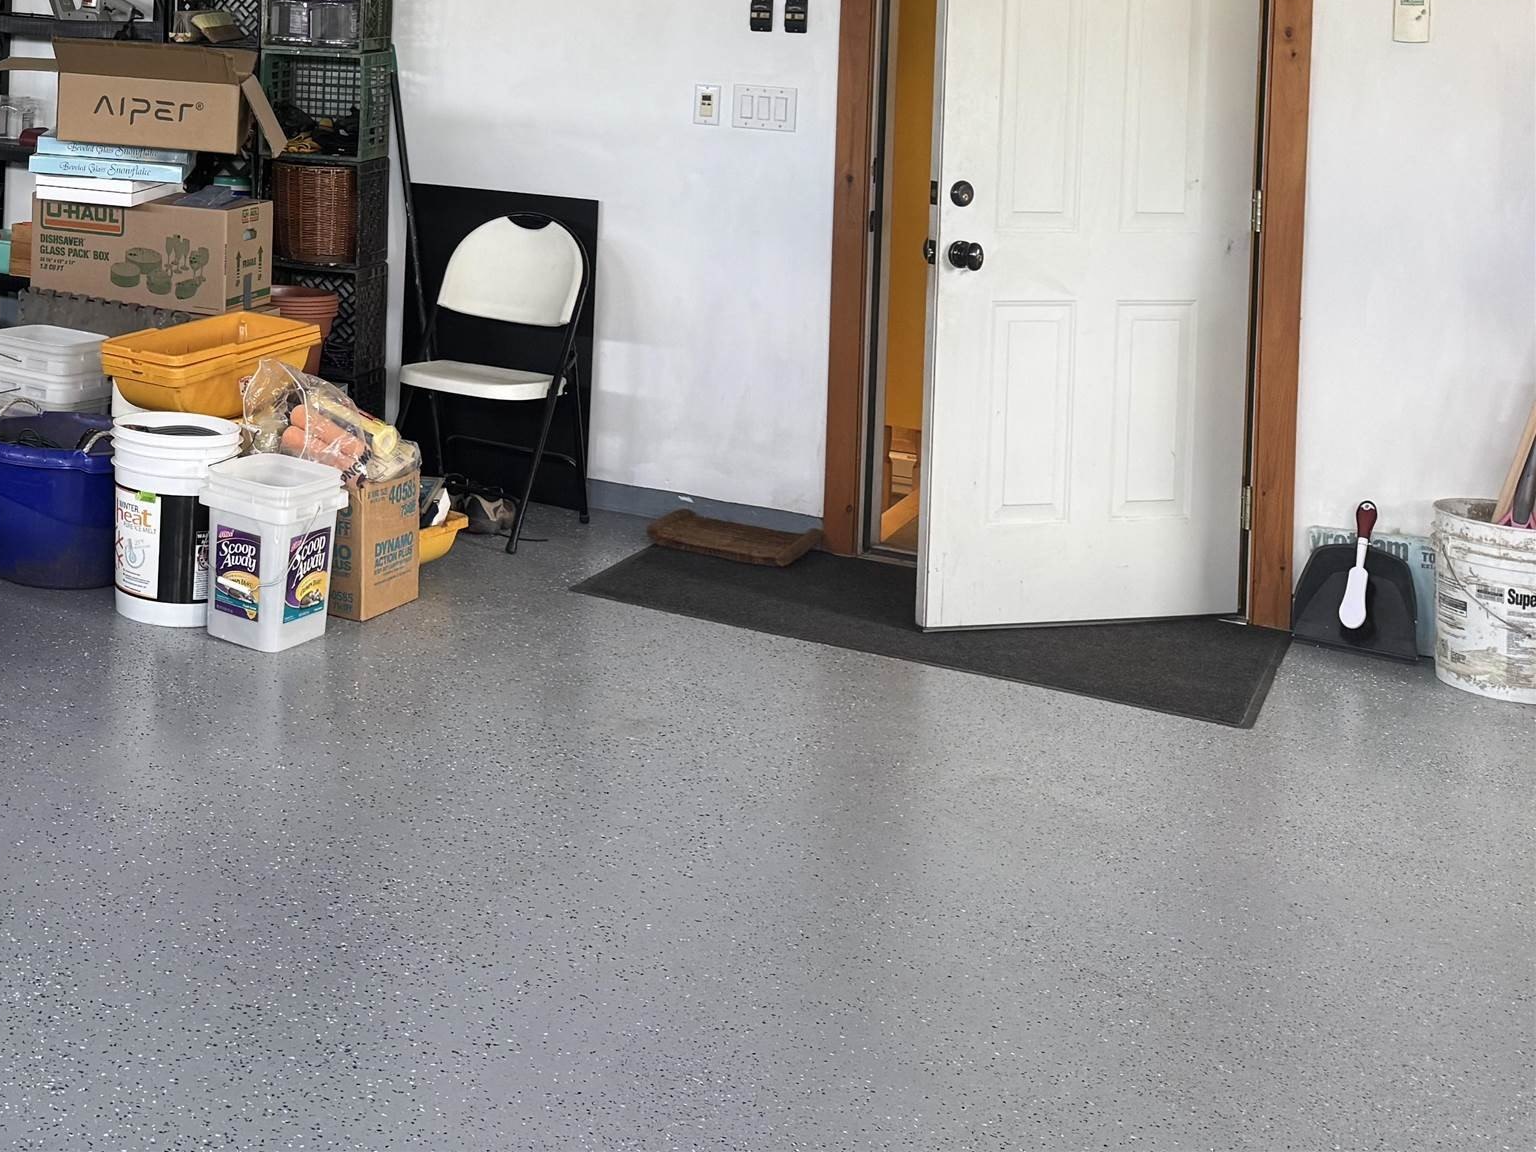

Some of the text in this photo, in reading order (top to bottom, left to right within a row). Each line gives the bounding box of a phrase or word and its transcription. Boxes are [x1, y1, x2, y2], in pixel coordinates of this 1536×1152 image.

[106, 163, 152, 178] Snowflake
[40, 233, 84, 247] DISHSAVER
[39, 244, 110, 261] GLASS PACK BOX
[115, 496, 153, 528] heat
[119, 499, 140, 513] WINTER
[219, 540, 256, 558] Scoop
[291, 535, 326, 571] Scoop
[375, 532, 414, 558] DYNAMO
[219, 553, 257, 572] Away
[291, 551, 326, 589] Away
